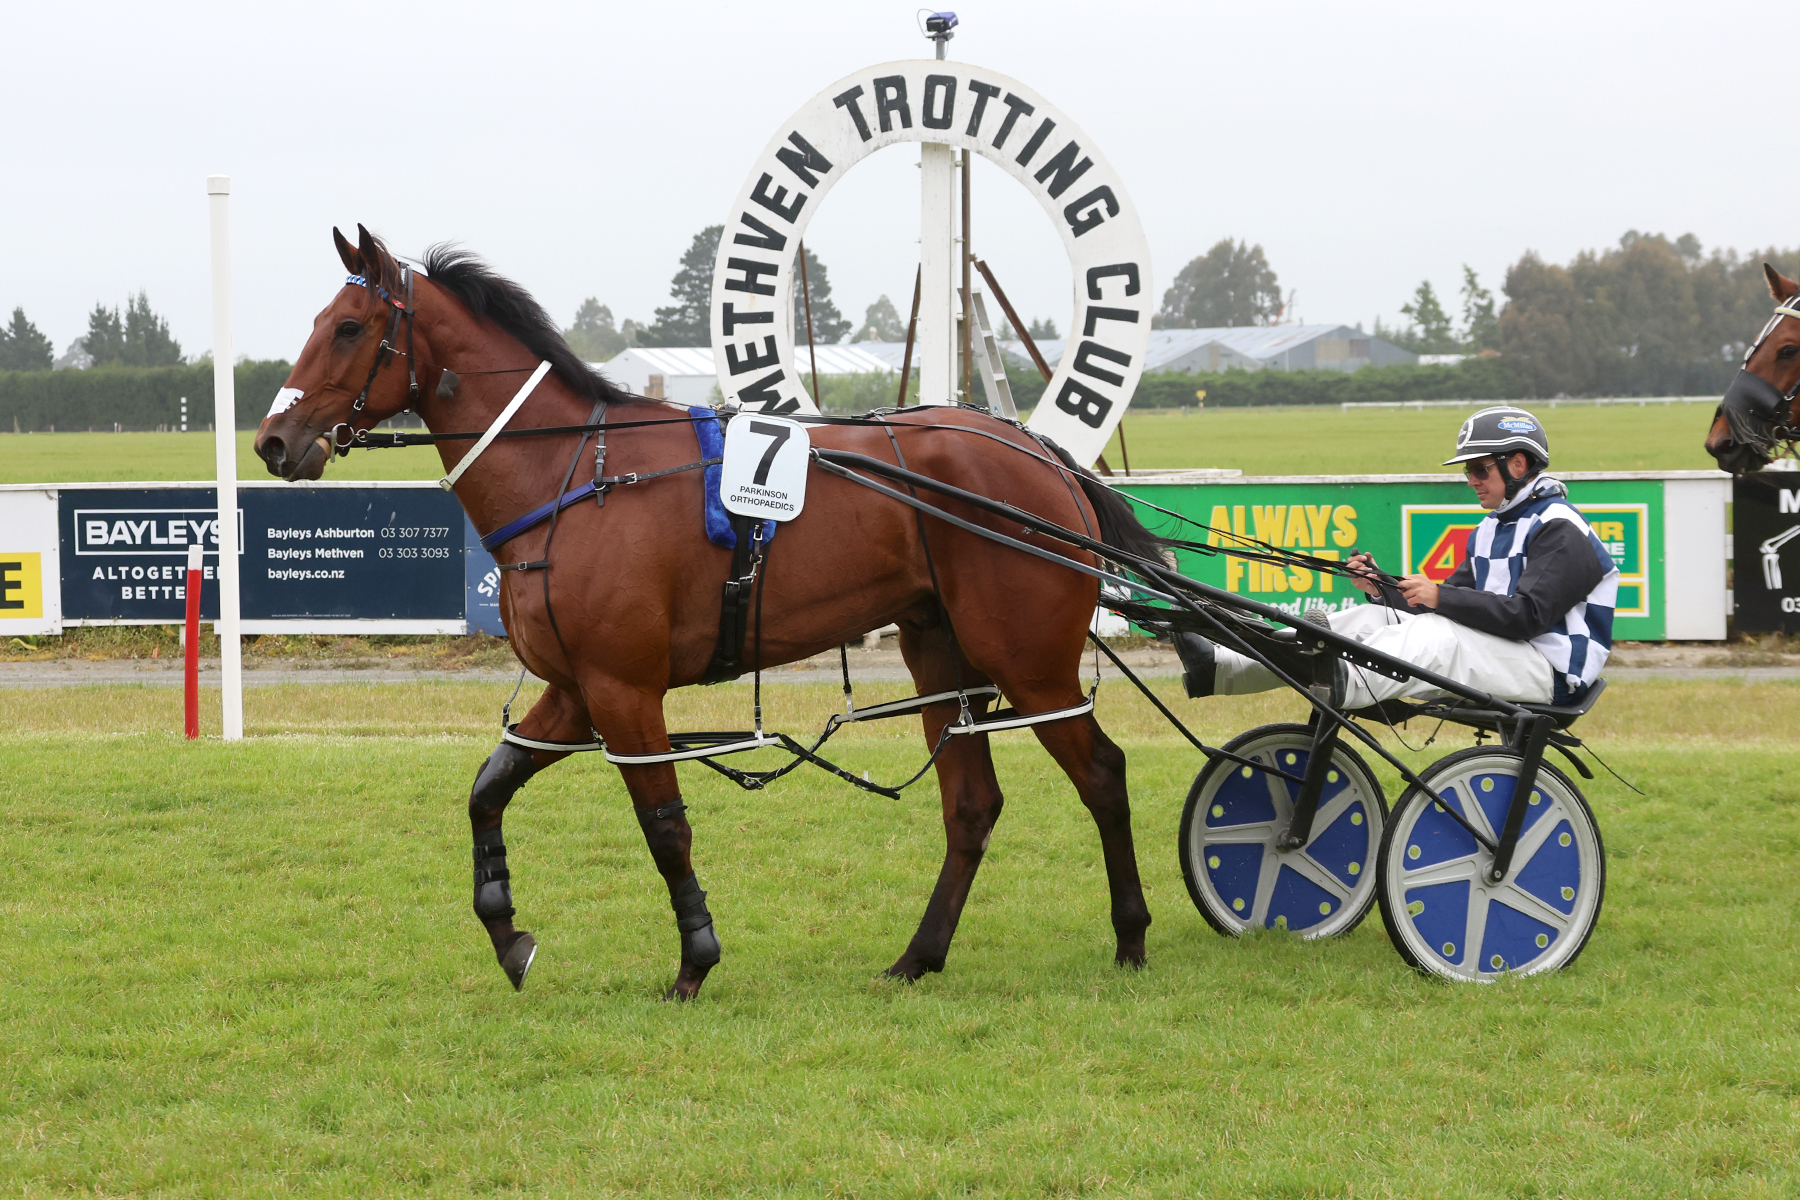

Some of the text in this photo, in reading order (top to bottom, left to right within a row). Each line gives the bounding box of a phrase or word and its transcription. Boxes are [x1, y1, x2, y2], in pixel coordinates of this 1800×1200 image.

[723, 74, 1140, 429] METHVEN TROTTING CLUB
[749, 420, 791, 486] 7
[740, 485, 788, 500] PARKINSON
[730, 494, 795, 512] ORTHOPAEDICS
[267, 527, 449, 540] Bayleys Ashburton 03 307 7377
[1207, 505, 1358, 547] ALWAYS
[267, 548, 449, 560] Bayleys Methven 03 303 3093
[92, 566, 220, 580] ALTOGETE
[268, 568, 345, 580] bayleys.co.nz
[1226, 550, 1340, 593] FIRST
[121, 586, 188, 599] BETTE
